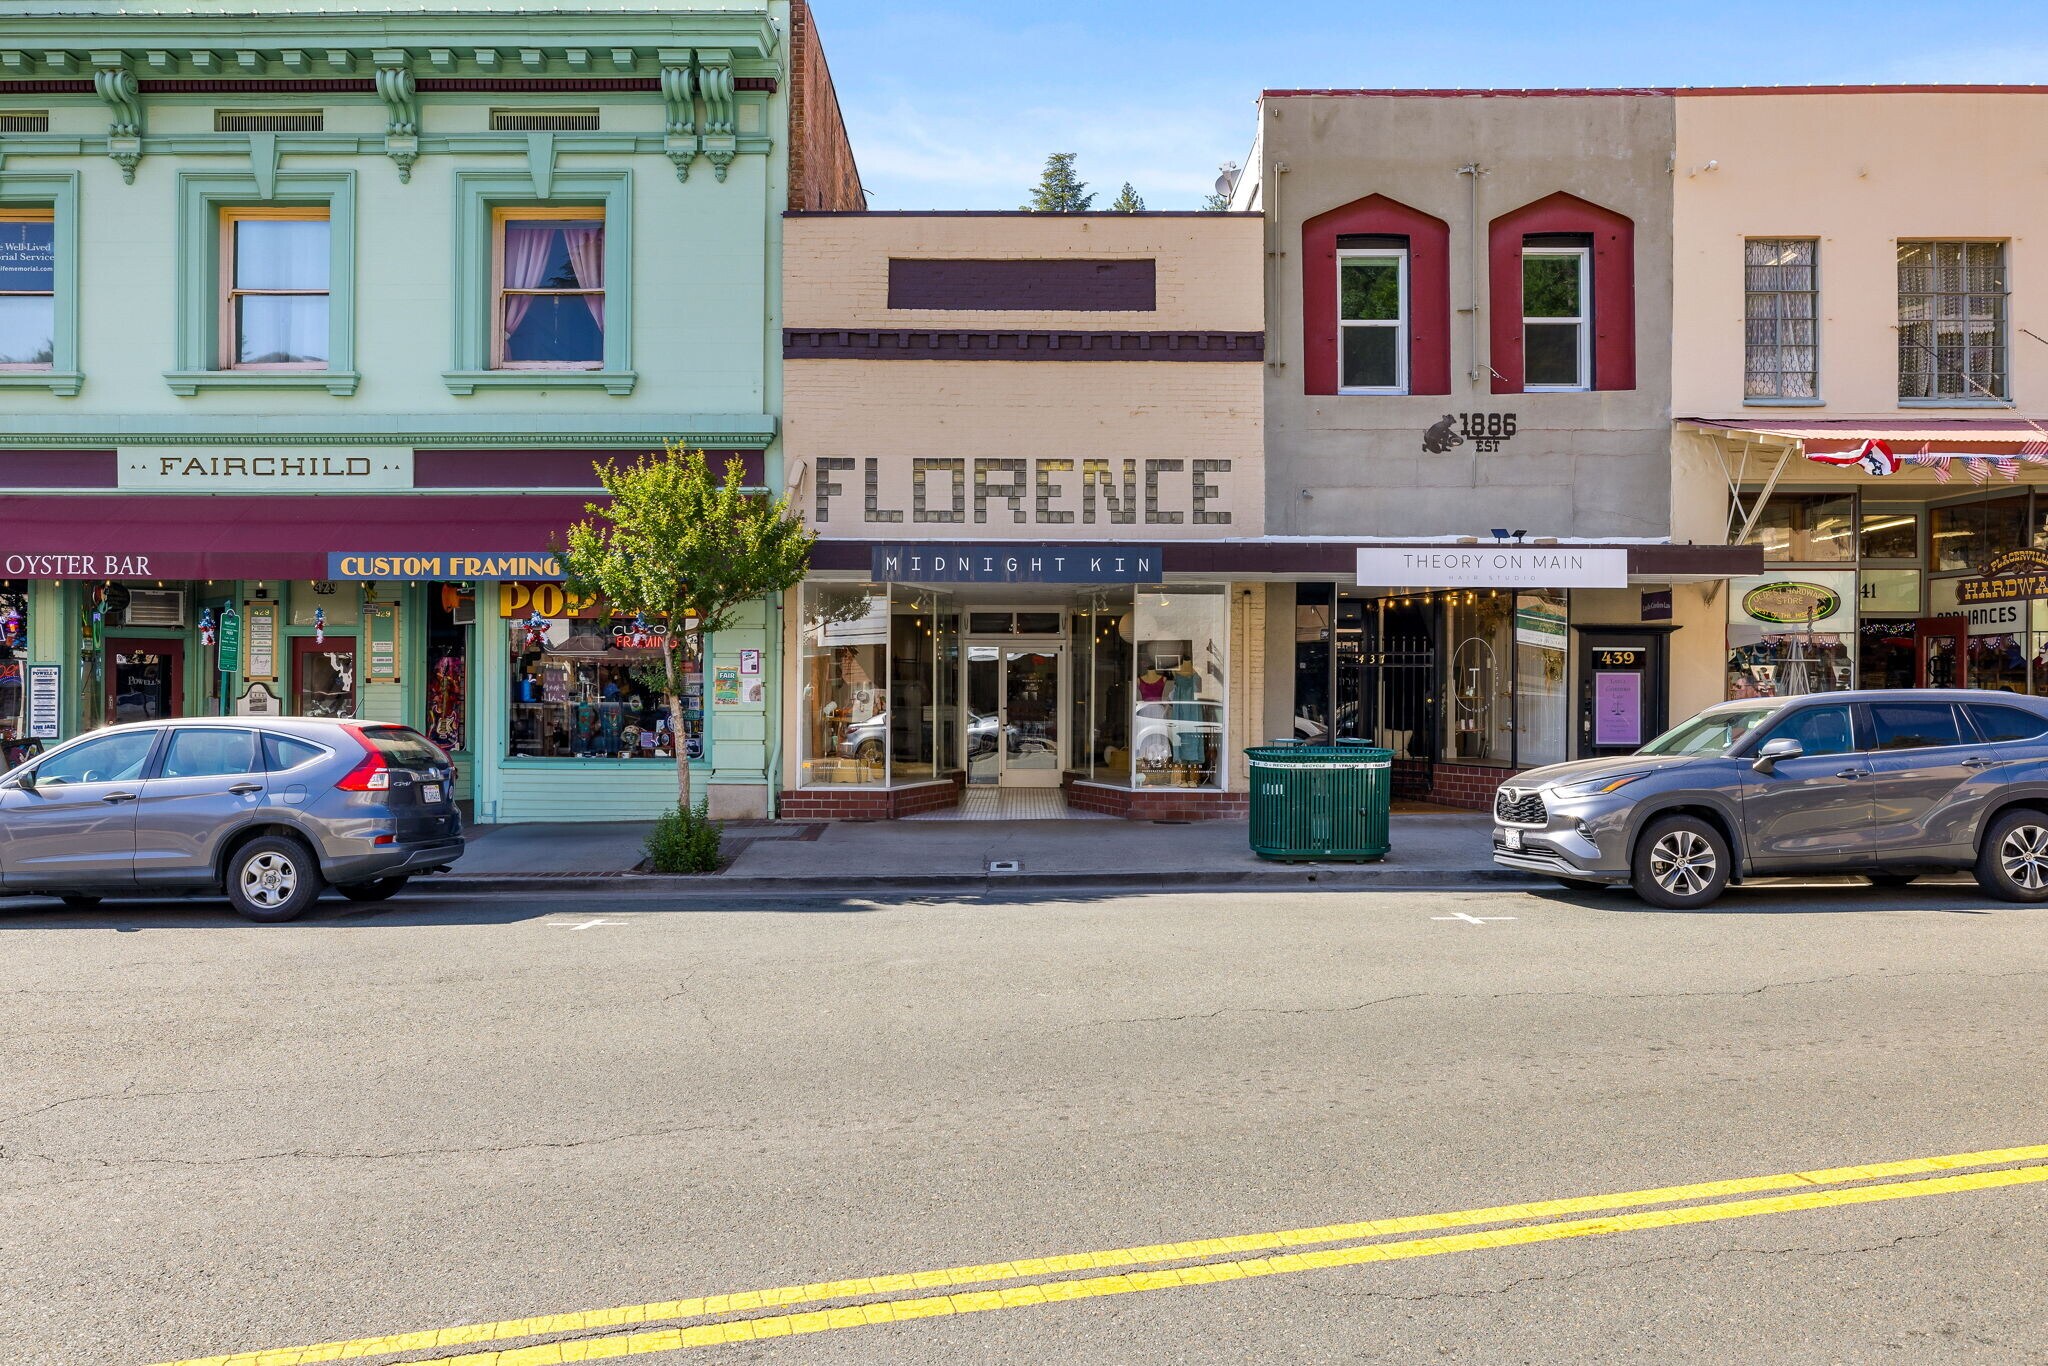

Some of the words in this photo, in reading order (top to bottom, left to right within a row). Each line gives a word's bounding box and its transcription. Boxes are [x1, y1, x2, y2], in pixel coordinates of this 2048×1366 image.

[5, 243, 51, 251] Well-Lived
[0, 253, 18, 261] rial
[1460, 413, 1517, 436] 1886
[1476, 441, 1500, 453] EST
[160, 457, 371, 476] FAIRCHILD
[816, 457, 1232, 525] FLORENCE
[5, 554, 98, 576] OYSTER
[104, 555, 152, 576] BAR
[340, 557, 441, 576] CUSTOM
[449, 557, 561, 576] FRAMING
[886, 556, 1066, 573] MIDNIGHT
[1091, 556, 1151, 573] KIN
[1404, 554, 1485, 570] THEORY
[1493, 554, 1523, 570] ON
[1533, 554, 1584, 570] MAIN
[1990, 550, 2048, 572] PLACERVILL
[313, 581, 337, 595] 429
[1776, 597, 1804, 606] STORE
[1601, 651, 1636, 665] 439
